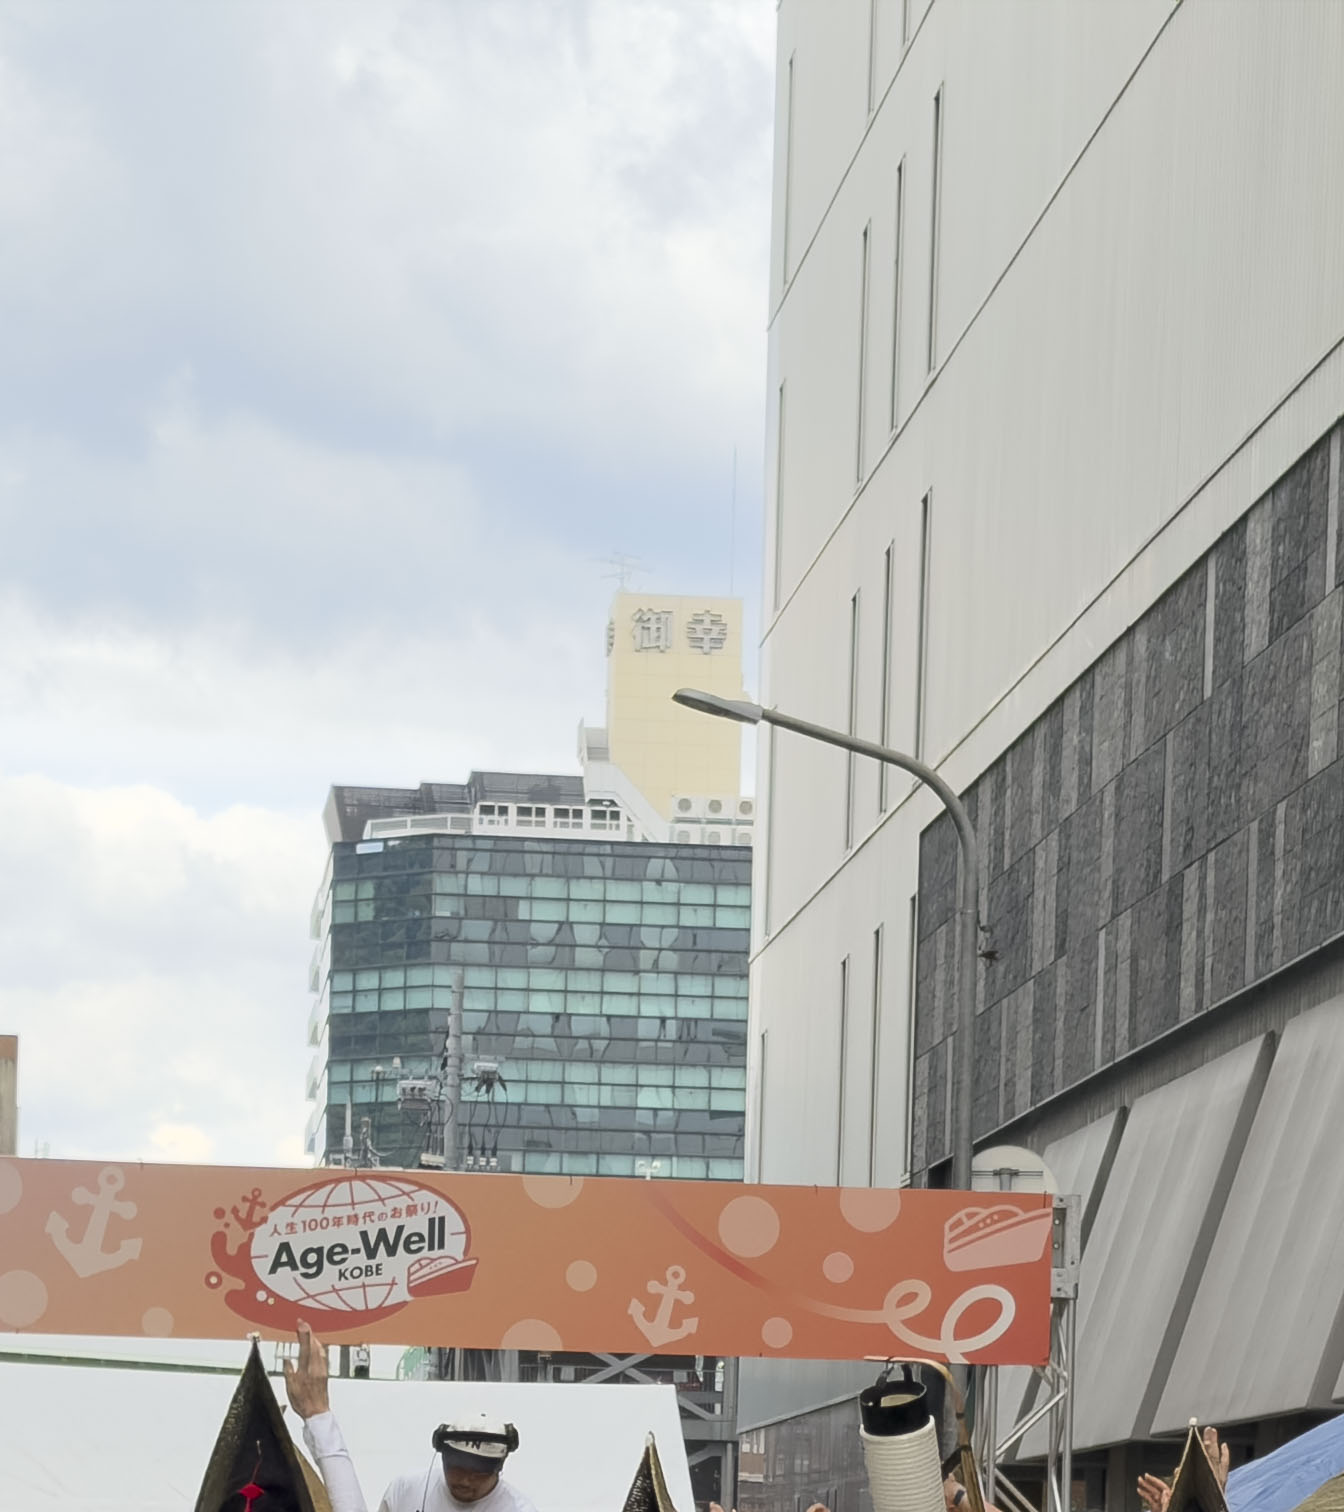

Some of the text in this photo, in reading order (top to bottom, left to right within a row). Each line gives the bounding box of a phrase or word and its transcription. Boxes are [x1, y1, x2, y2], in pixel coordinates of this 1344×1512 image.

[631, 607, 728, 656] 御幸
[268, 1215, 446, 1280] Age-Well
[338, 1263, 384, 1282] KOBE
